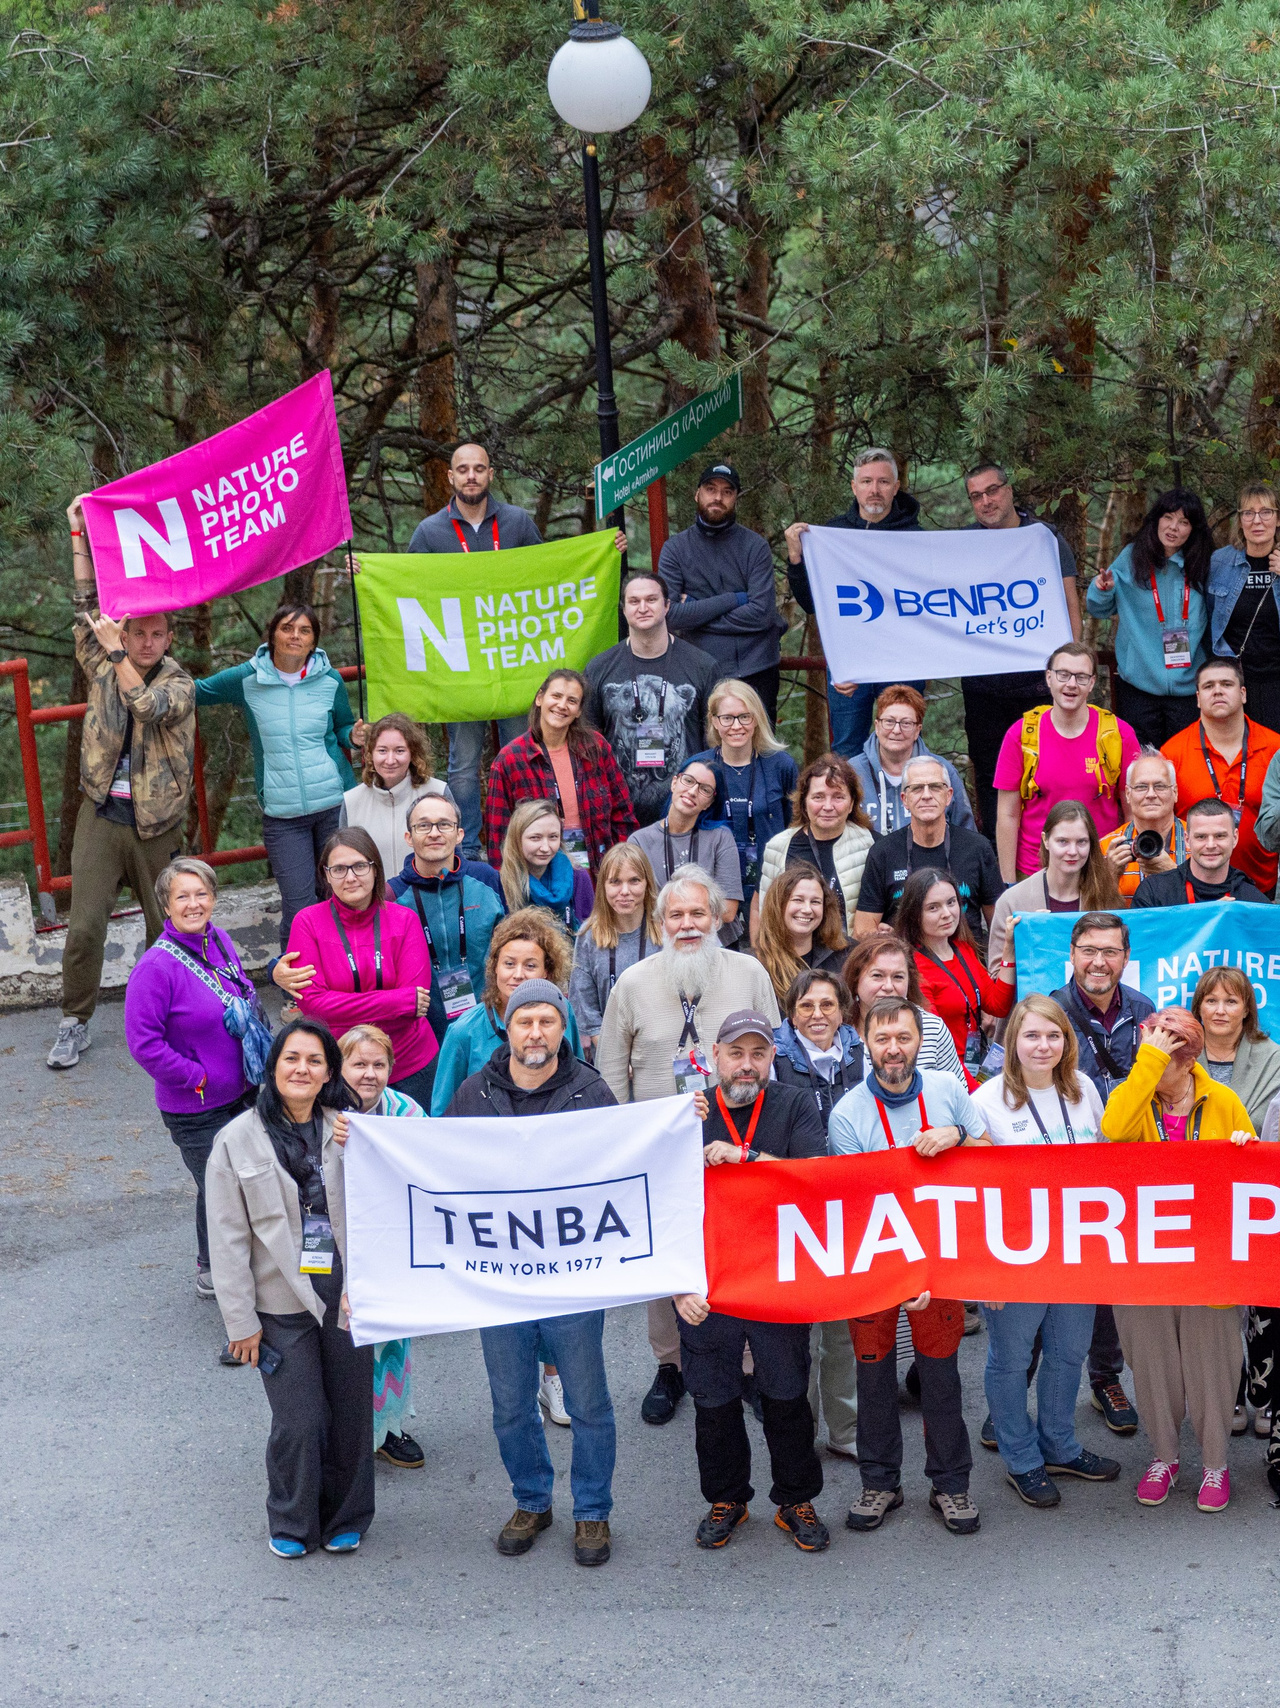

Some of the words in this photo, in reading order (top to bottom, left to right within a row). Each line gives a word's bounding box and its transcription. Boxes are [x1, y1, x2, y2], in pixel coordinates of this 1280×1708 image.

[192, 432, 308, 511] NATURE
[613, 421, 680, 482] Гостиница
[201, 467, 299, 537] PHOTO
[614, 481, 631, 503] Hotel
[113, 497, 194, 579] N
[204, 502, 286, 559] TEAM
[474, 575, 598, 618] NATURE
[1247, 574, 1271, 585] ENB
[396, 597, 471, 673] N
[478, 606, 584, 645] PHOTO
[965, 616, 1008, 636] Let's
[1013, 609, 1045, 638] go!
[480, 637, 566, 671] TEAM
[1157, 985, 1268, 1009] PHO
[1088, 1036, 1098, 1054] Canon
[434, 1200, 631, 1250] TENBA
[778, 1184, 1196, 1283] NATURE
[466, 1259, 503, 1274] NEW
[510, 1261, 559, 1276] YORK
[566, 1257, 603, 1272] 1977
